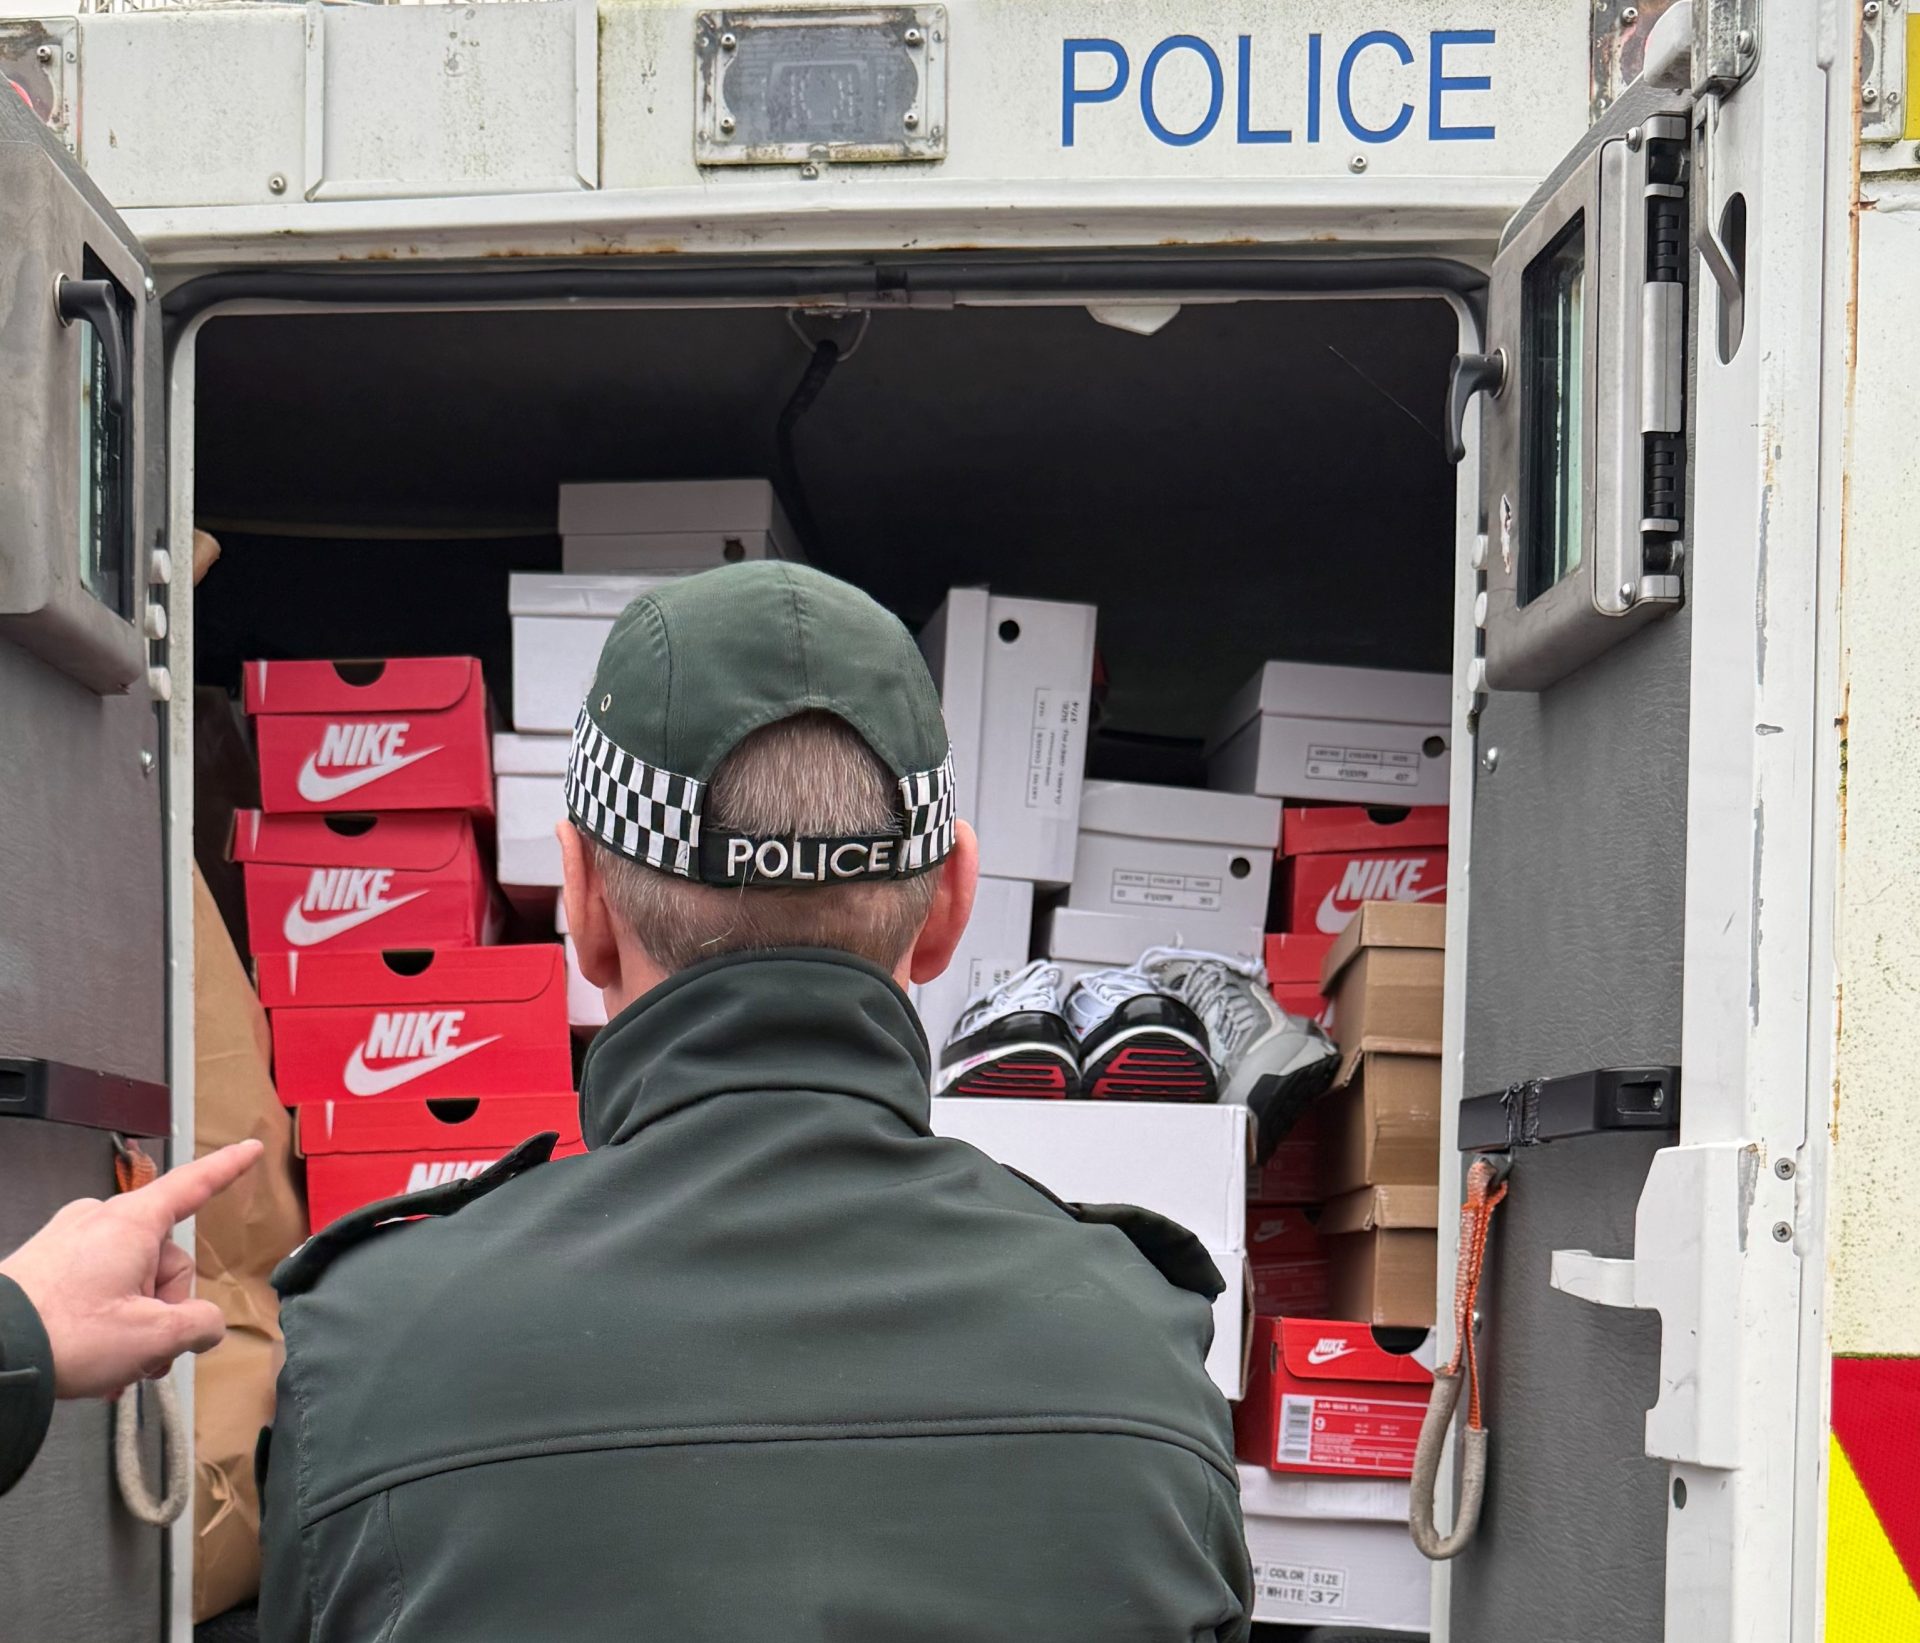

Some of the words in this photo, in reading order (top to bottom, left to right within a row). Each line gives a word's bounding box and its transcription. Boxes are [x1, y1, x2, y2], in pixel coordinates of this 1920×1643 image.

[1062, 29, 1496, 147] POLICE
[317, 722, 410, 767] NIKE
[727, 838, 893, 881] POLICE
[1335, 859, 1428, 902] NIKE
[303, 868, 395, 911] NIKE
[365, 1011, 466, 1059] NIKE
[1315, 1338, 1348, 1355] NIKE
[1314, 1416, 1326, 1431] 9
[1266, 1586, 1304, 1601] WHITE
[1309, 1590, 1340, 1604] 37
[1269, 1567, 1304, 1582] COLOR
[1313, 1573, 1338, 1586] SIZE
